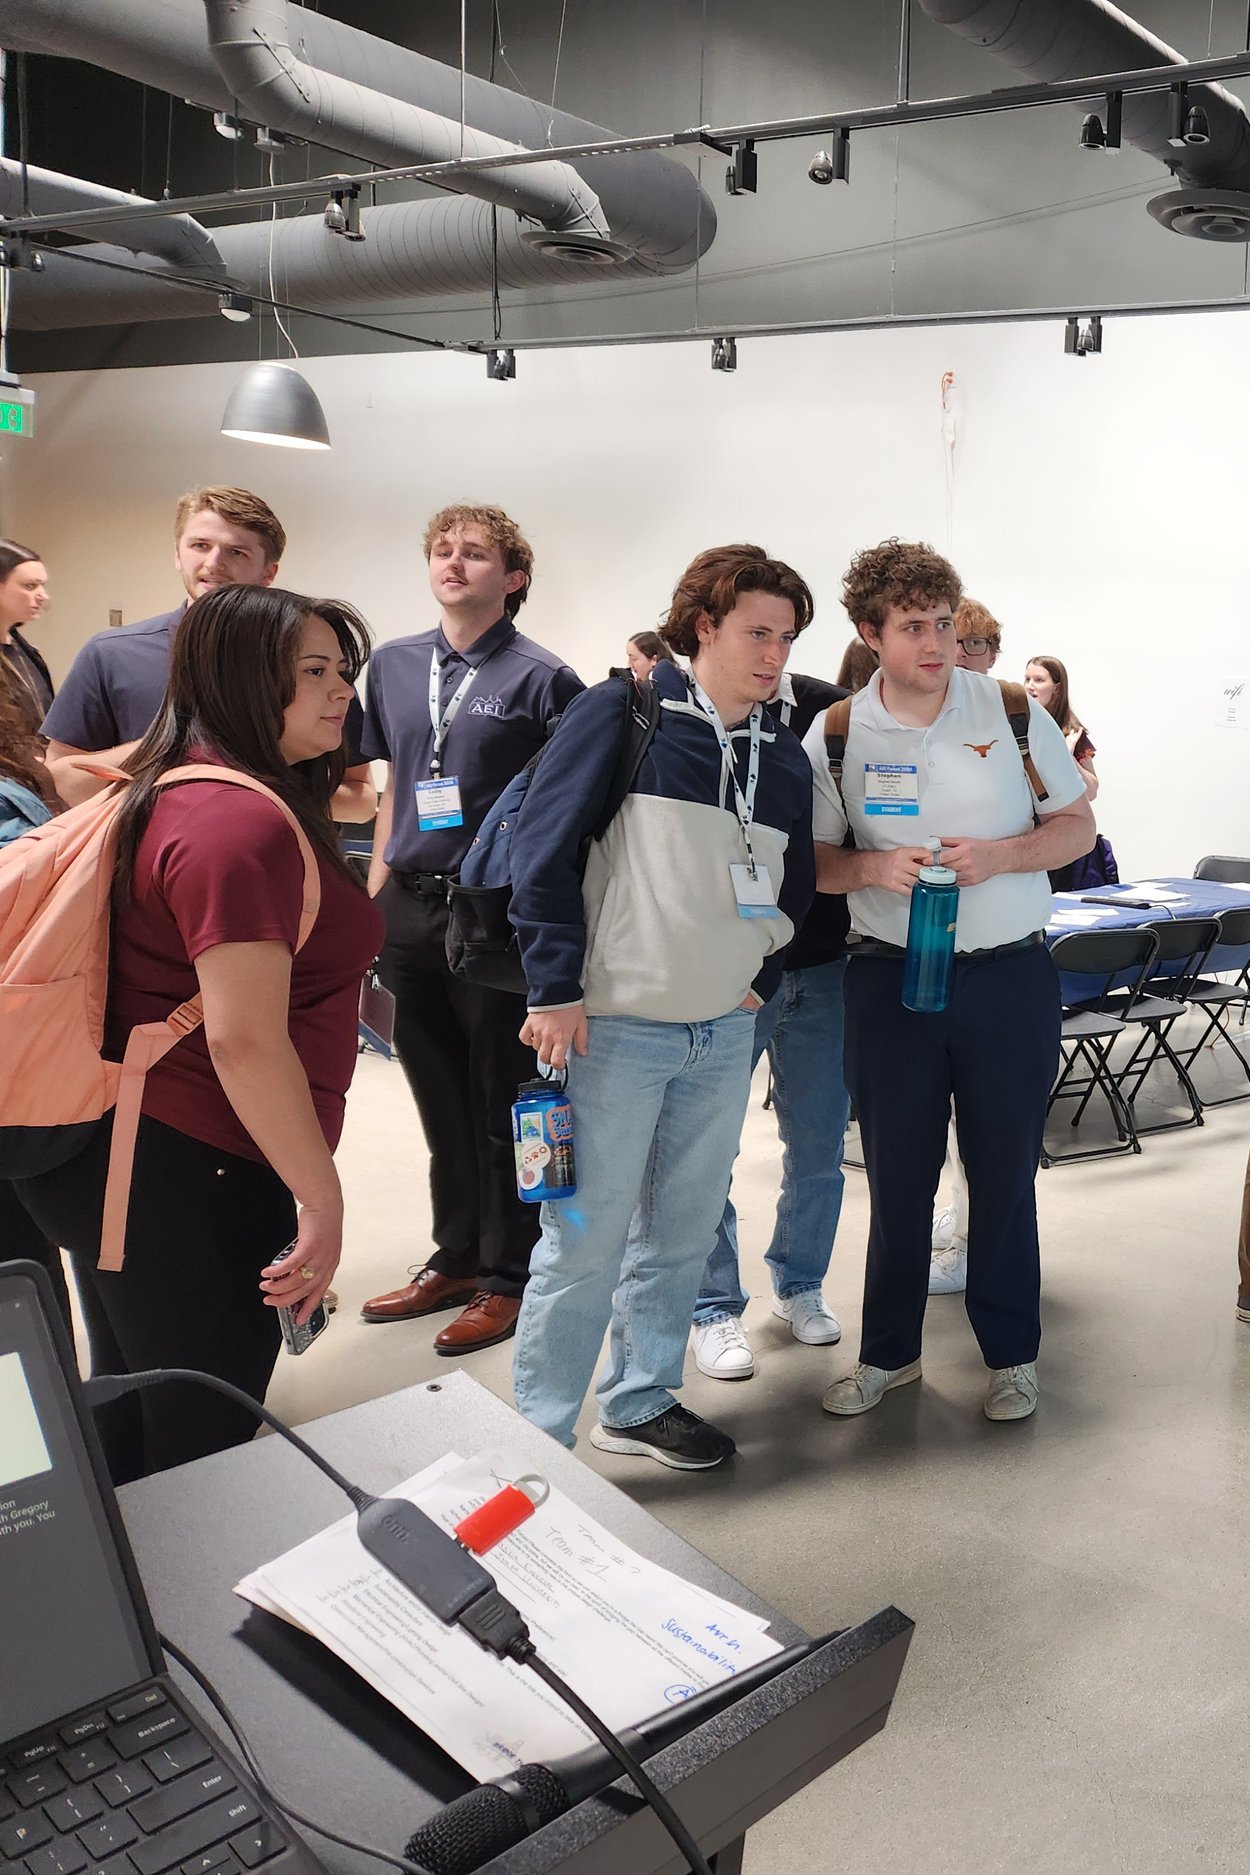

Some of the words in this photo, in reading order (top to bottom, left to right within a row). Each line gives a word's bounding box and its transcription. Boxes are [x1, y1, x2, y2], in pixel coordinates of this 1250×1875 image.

[472, 705, 499, 715] AEI
[10, 1500, 49, 1519] Gregory
[14, 1518, 35, 1533] you.
[36, 1510, 56, 1523] You
[544, 1527, 574, 1558] Team
[74, 1723, 94, 1734] PgDn
[138, 1717, 176, 1738] Backspace
[202, 1775, 222, 1789] Enter
[228, 1804, 247, 1817] Shift
